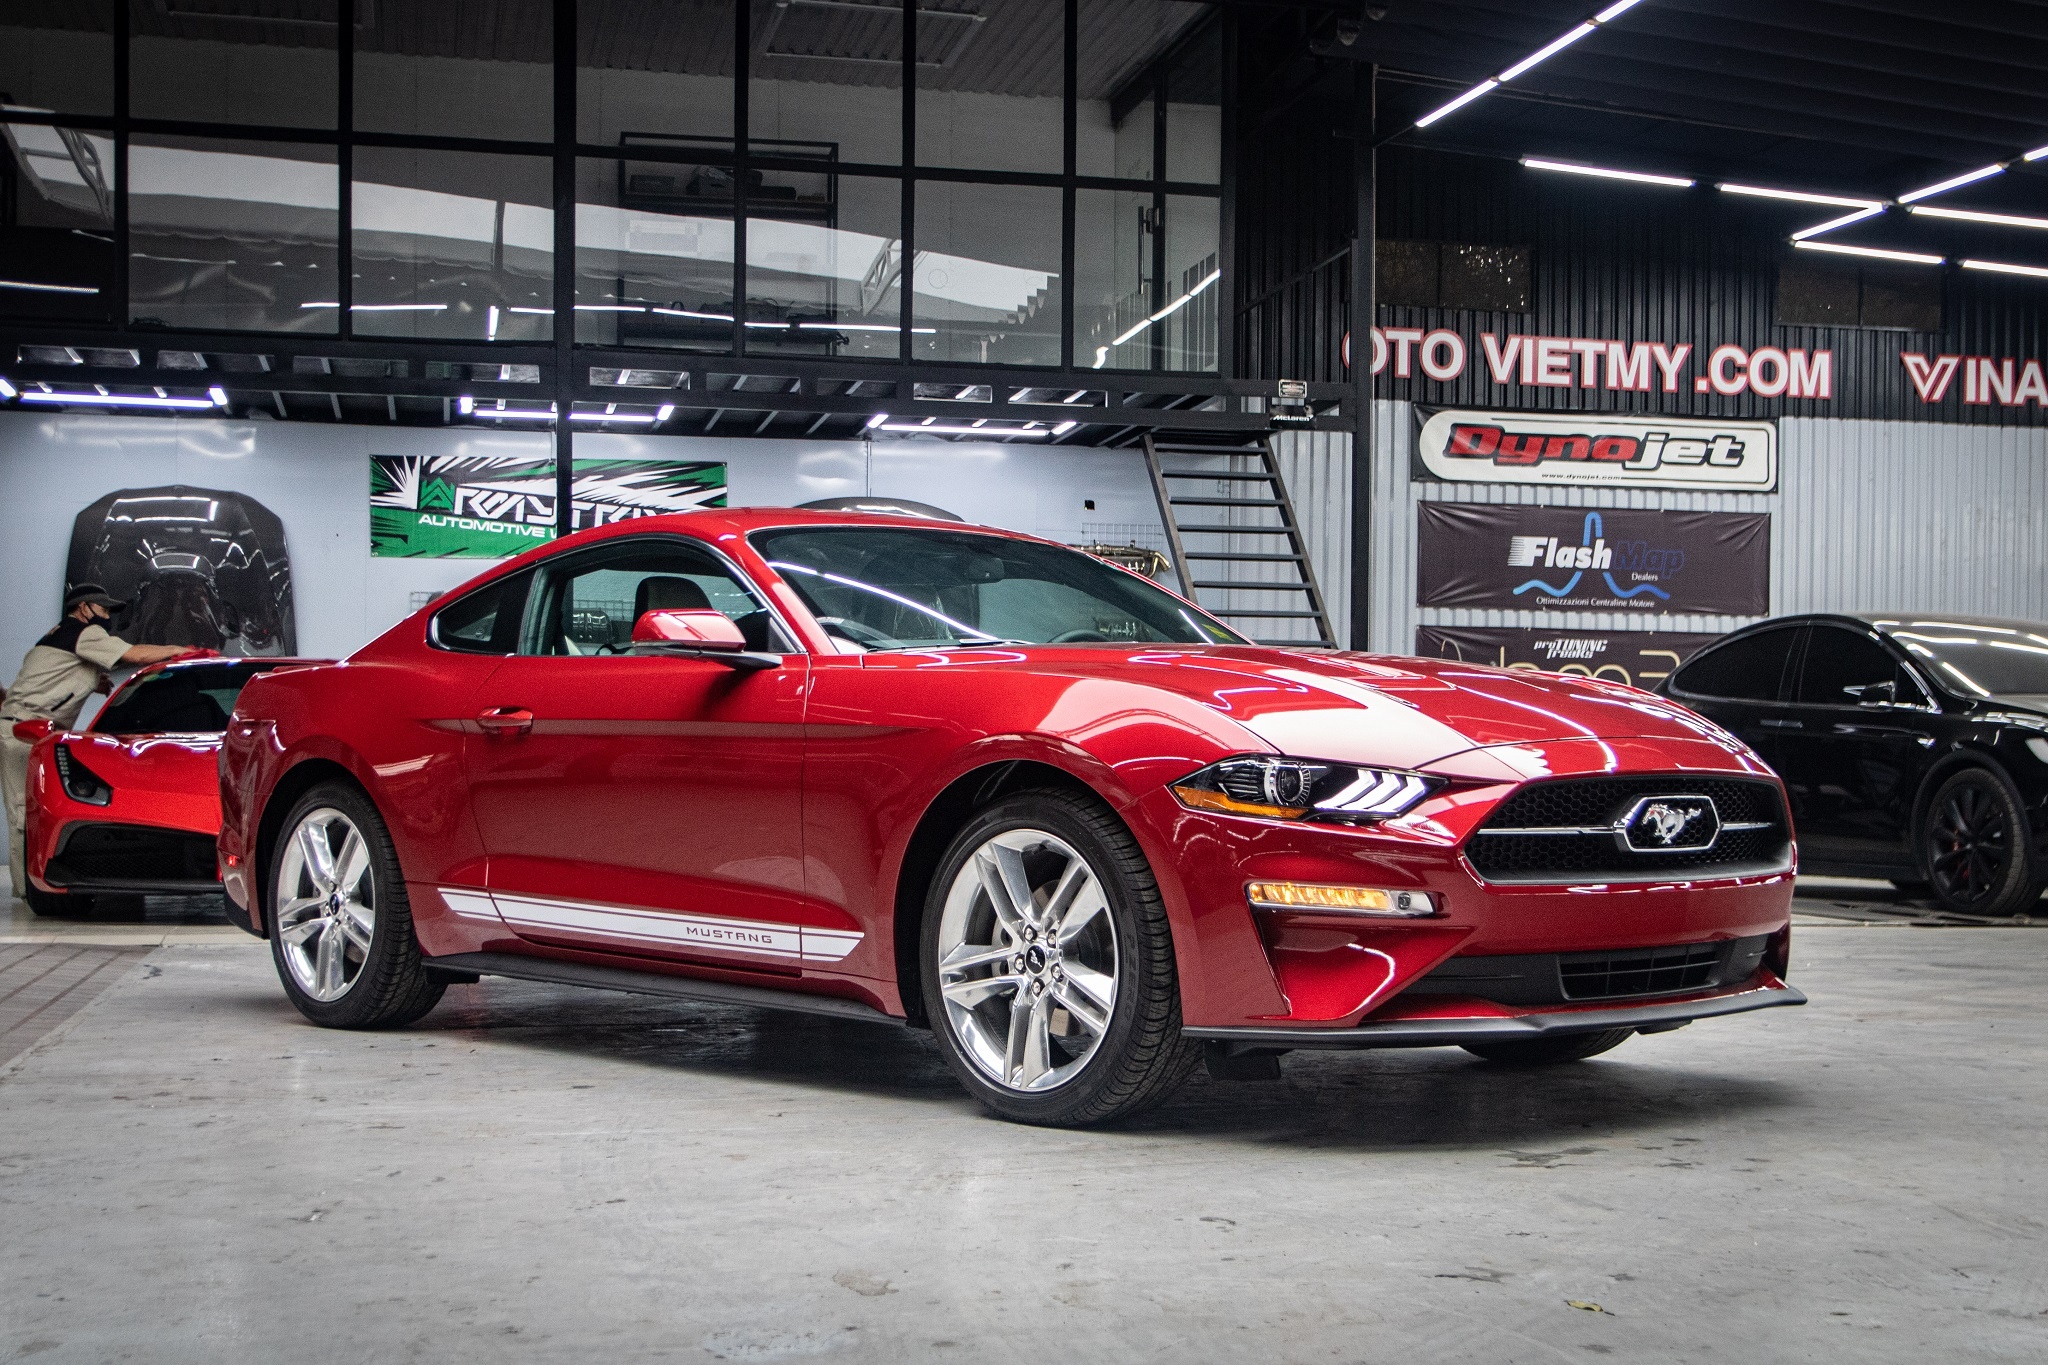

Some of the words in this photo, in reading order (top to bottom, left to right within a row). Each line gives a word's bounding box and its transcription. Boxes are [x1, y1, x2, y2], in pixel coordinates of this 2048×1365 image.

[1443, 422, 1746, 471] Dynojet
[1541, 472, 1621, 482] www.dynojet.com
[419, 514, 546, 538] AUTOMOTIVE
[1631, 571, 1658, 582] Dealers
[1536, 596, 1590, 607] Ottimizzazioni
[1590, 597, 1627, 608] Centraline
[1628, 598, 1655, 608] Motore
[686, 926, 772, 944] MUSTANG
